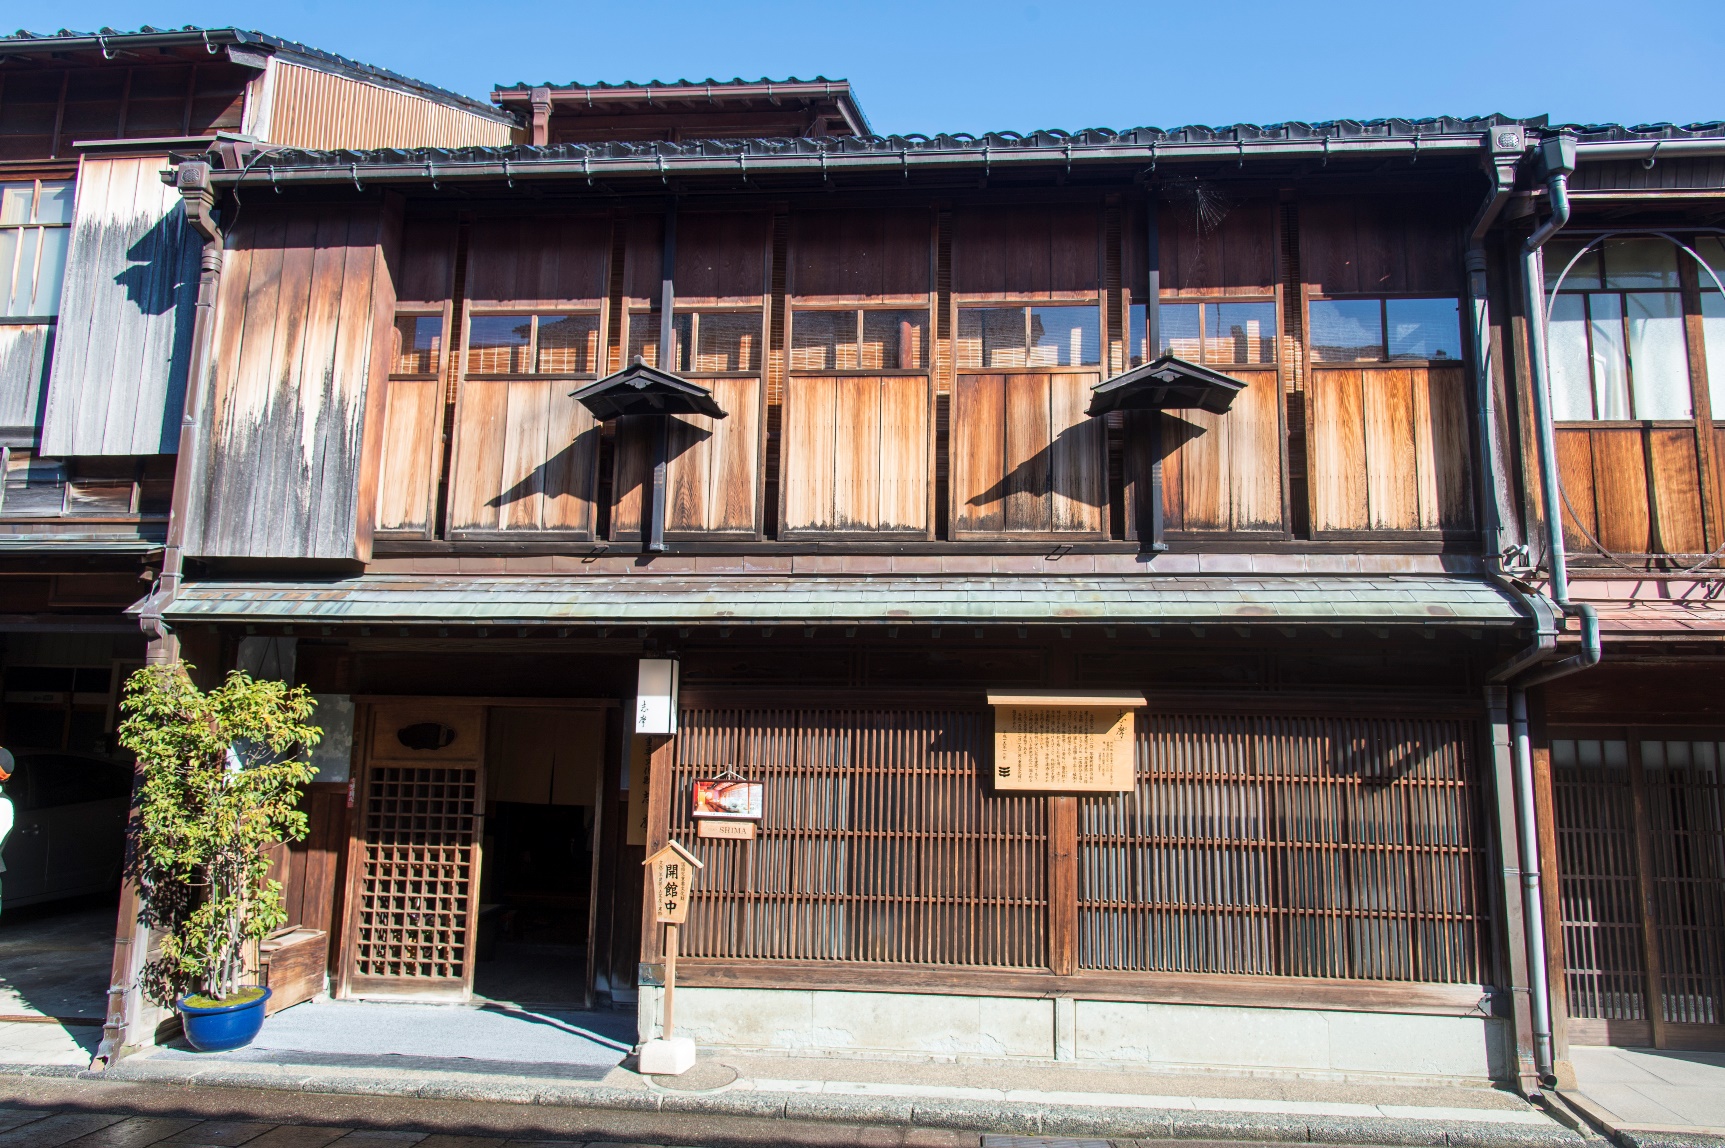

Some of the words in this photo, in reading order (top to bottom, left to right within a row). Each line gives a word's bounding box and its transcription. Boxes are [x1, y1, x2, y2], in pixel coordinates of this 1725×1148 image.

[719, 826, 747, 835] SHIMA
[664, 864, 679, 915] 開館中
